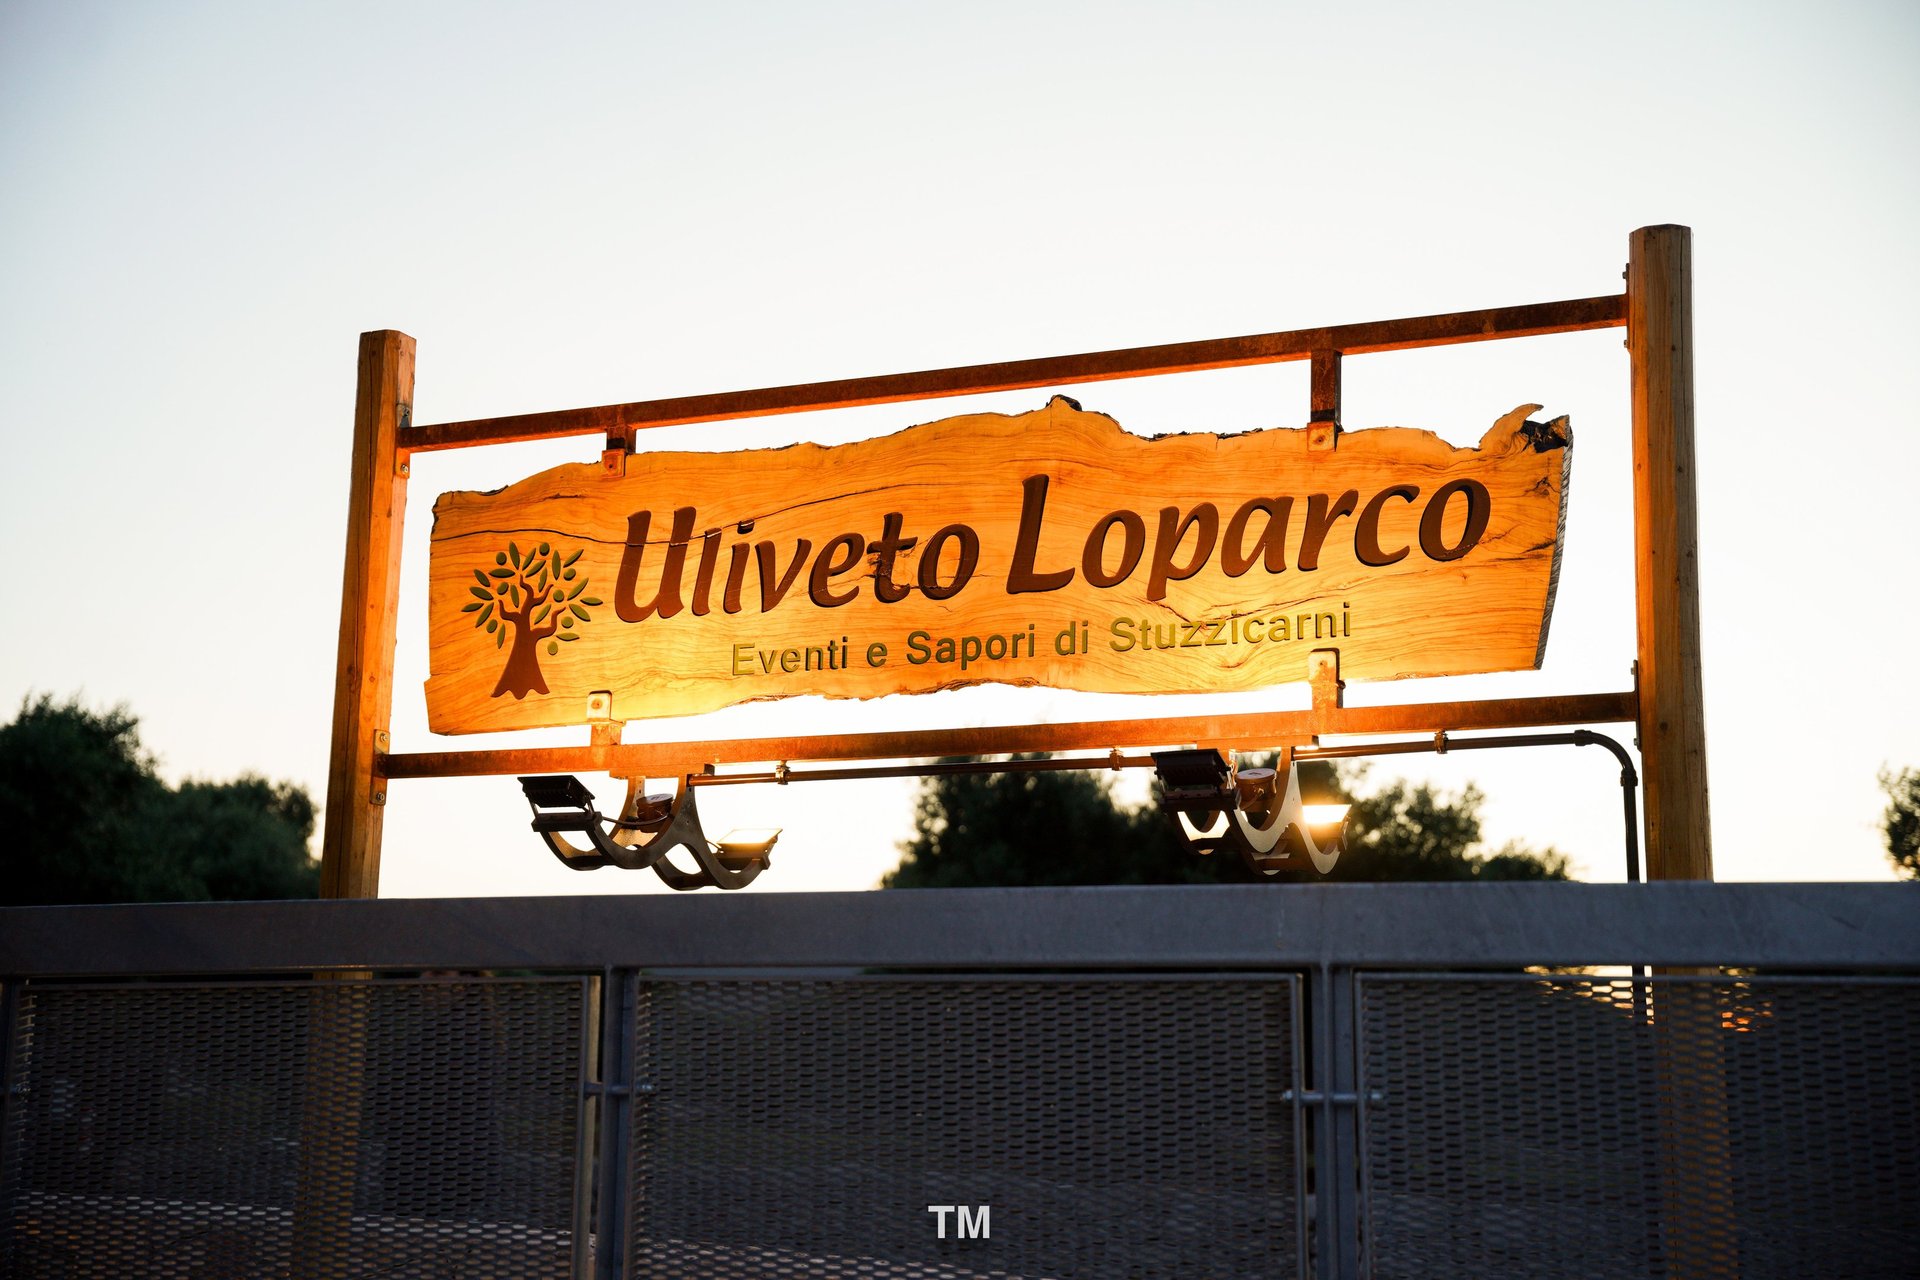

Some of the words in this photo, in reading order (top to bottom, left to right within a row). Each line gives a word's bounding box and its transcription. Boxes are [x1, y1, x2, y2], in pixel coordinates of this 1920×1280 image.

[614, 506, 981, 623] Uliveto
[1007, 474, 1491, 602] Loparco
[732, 637, 849, 677] Eventi
[866, 638, 888, 666] e
[906, 624, 1036, 671] Sapori
[1055, 620, 1089, 656] di
[1108, 602, 1352, 652] Stuzzicarni
